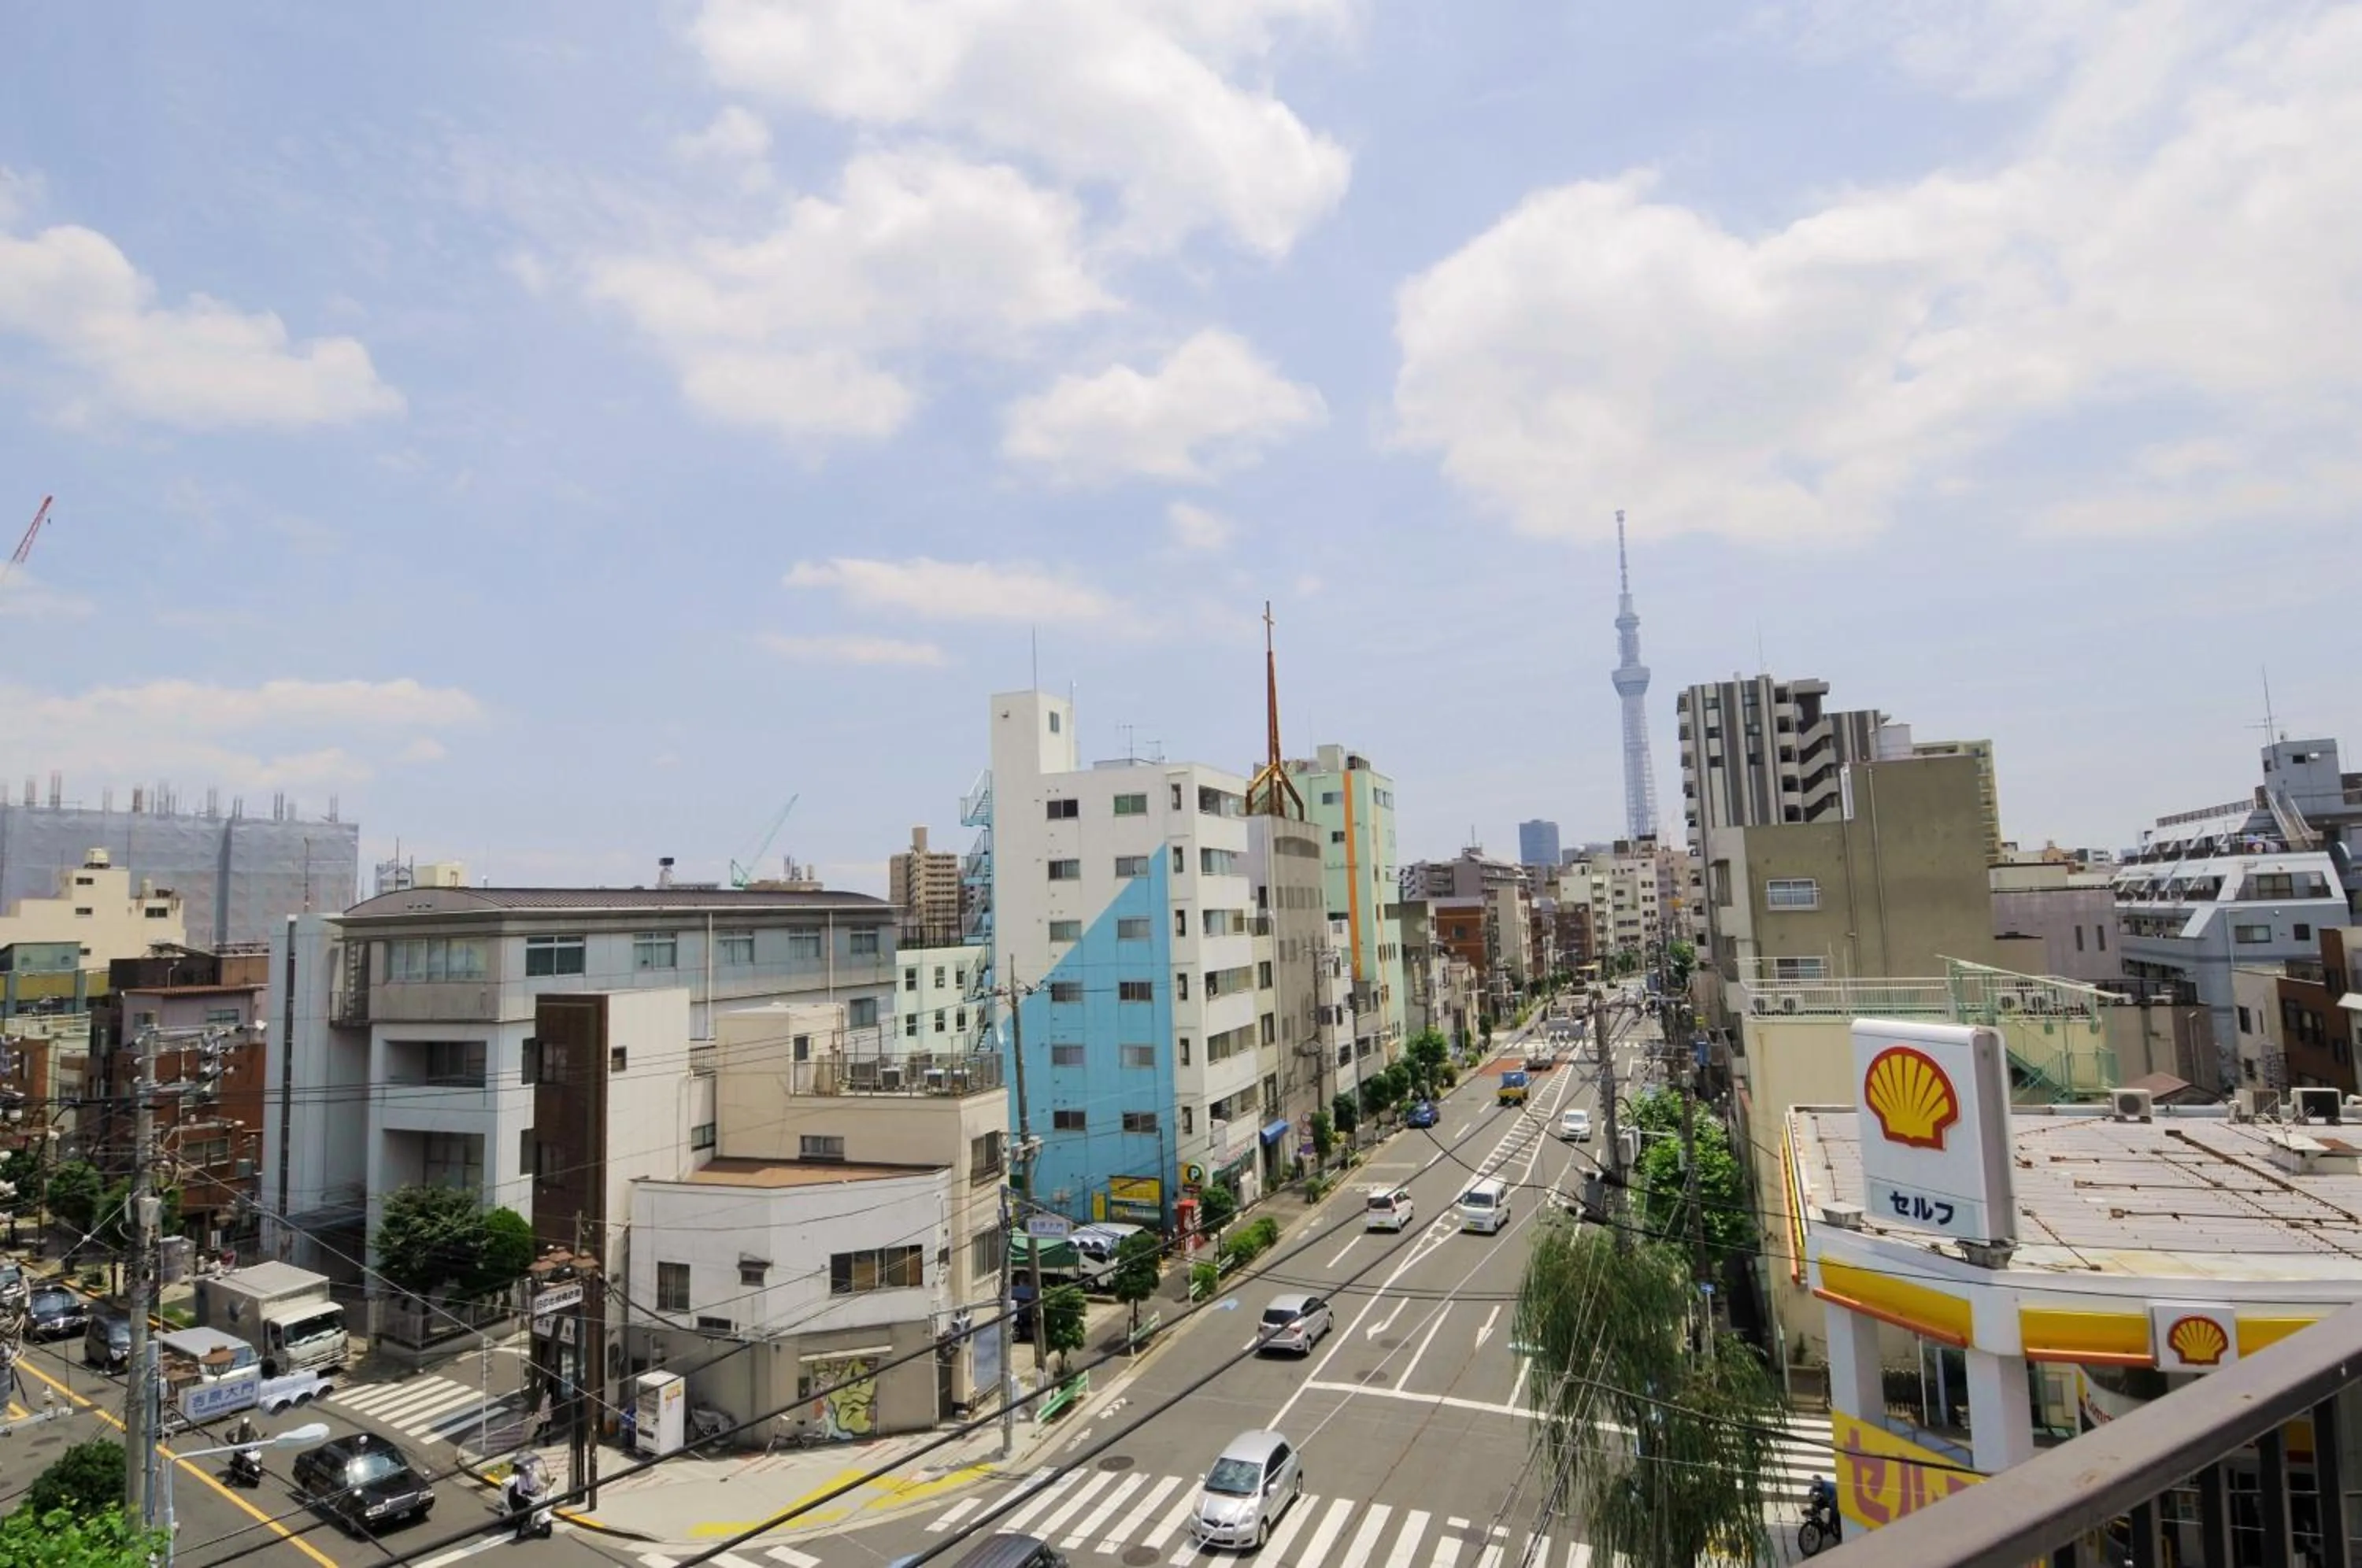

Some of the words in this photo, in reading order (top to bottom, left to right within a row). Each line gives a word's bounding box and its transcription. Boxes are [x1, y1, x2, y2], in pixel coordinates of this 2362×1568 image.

[1190, 1167, 1199, 1181] P
[1890, 1190, 1954, 1226] セルフ
[1843, 1426, 1970, 1525] セル
